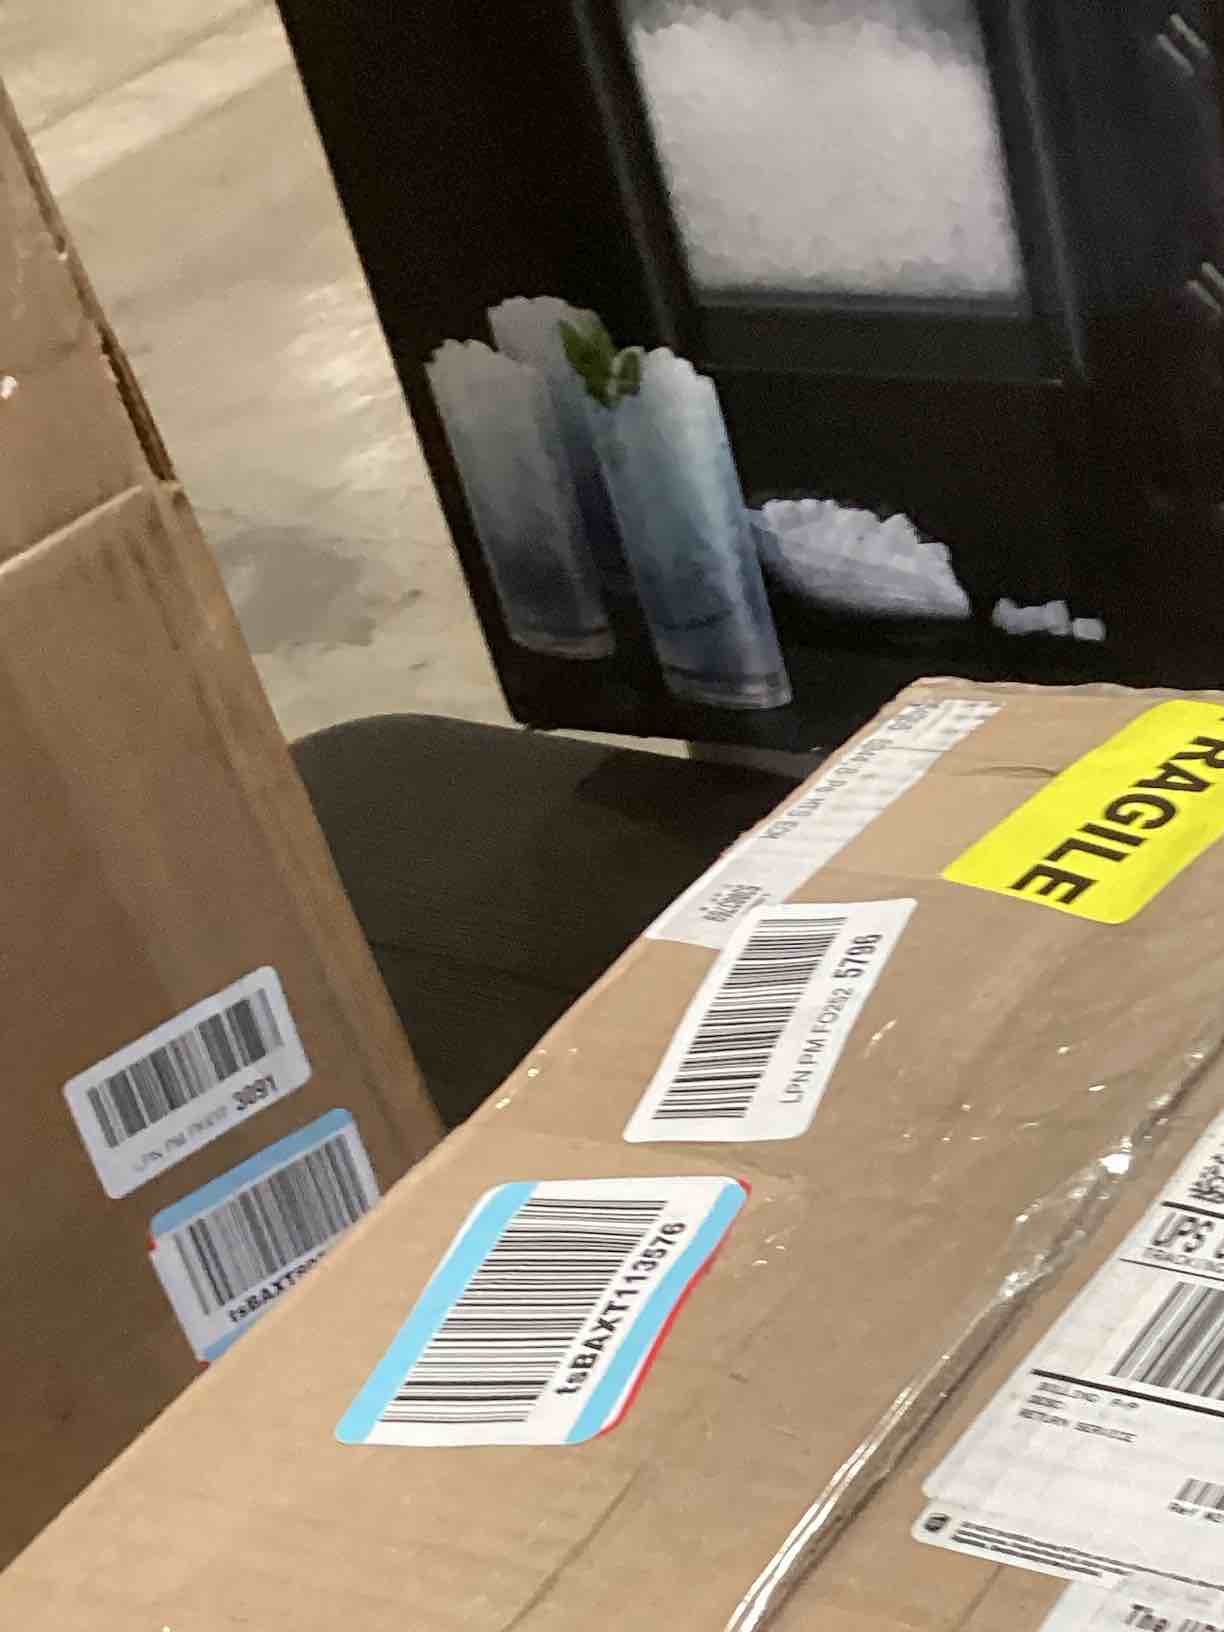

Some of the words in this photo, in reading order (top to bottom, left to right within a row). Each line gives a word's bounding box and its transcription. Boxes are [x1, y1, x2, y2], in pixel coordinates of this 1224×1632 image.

[779, 1069, 813, 1104] LPN
[831, 933, 883, 979] 5796
[1152, 1212, 1216, 1254] UPS
[555, 1222, 687, 1395] tsBAXT113576
[1125, 1602, 1170, 1632] The
